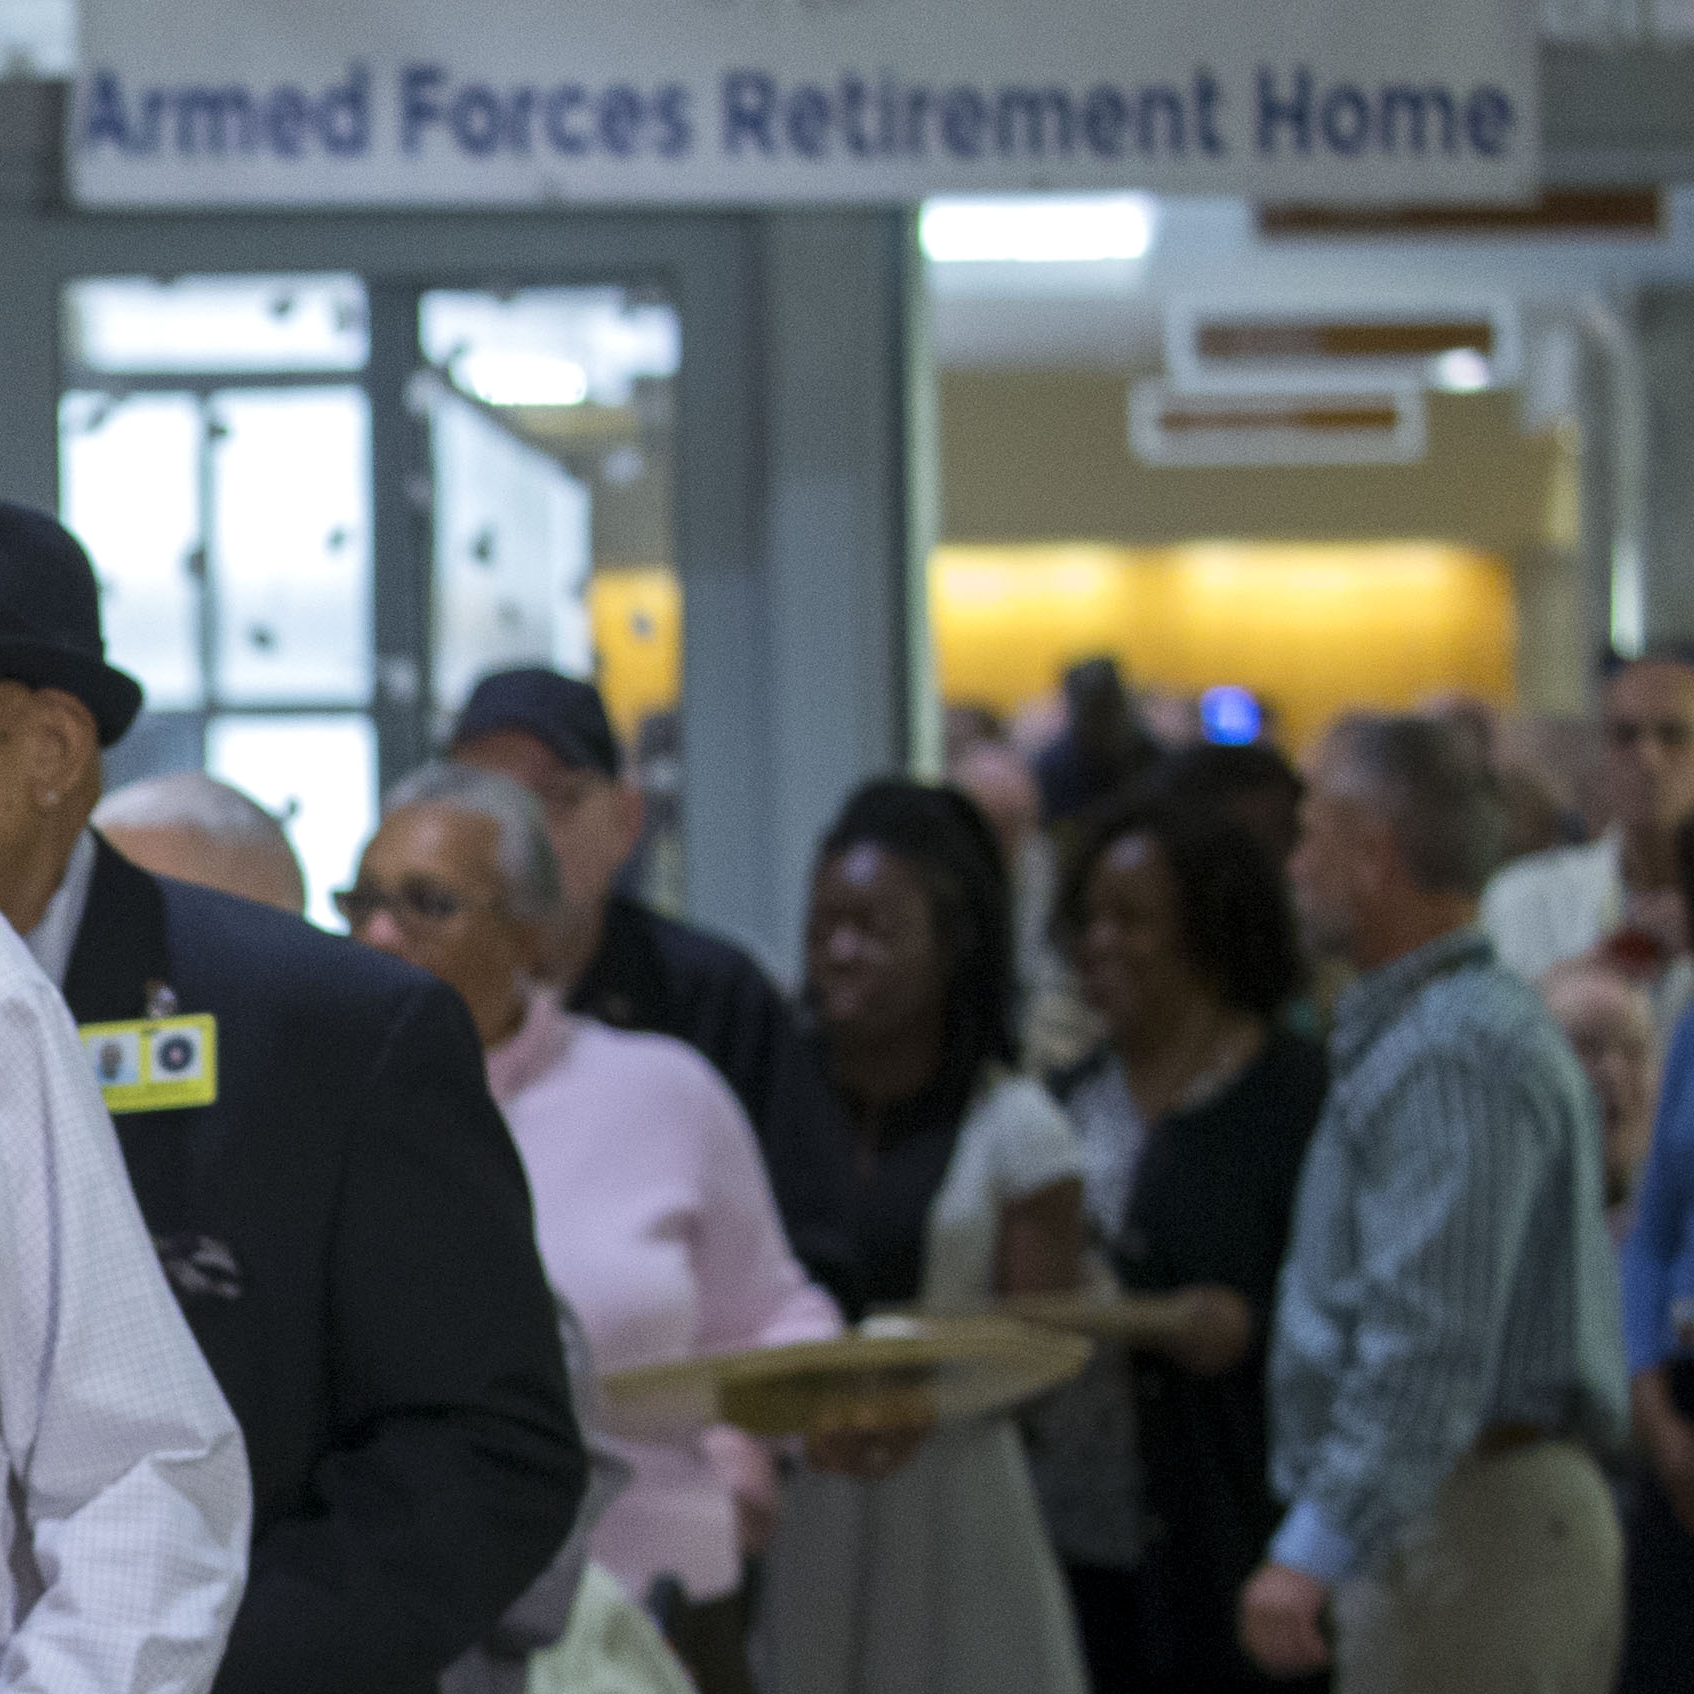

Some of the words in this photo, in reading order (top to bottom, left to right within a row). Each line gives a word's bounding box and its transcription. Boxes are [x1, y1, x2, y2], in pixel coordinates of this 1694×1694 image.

[81, 58, 370, 160] Armed
[400, 62, 695, 160] Forces
[719, 62, 1226, 161] Retirement
[1252, 62, 1514, 158] Home
